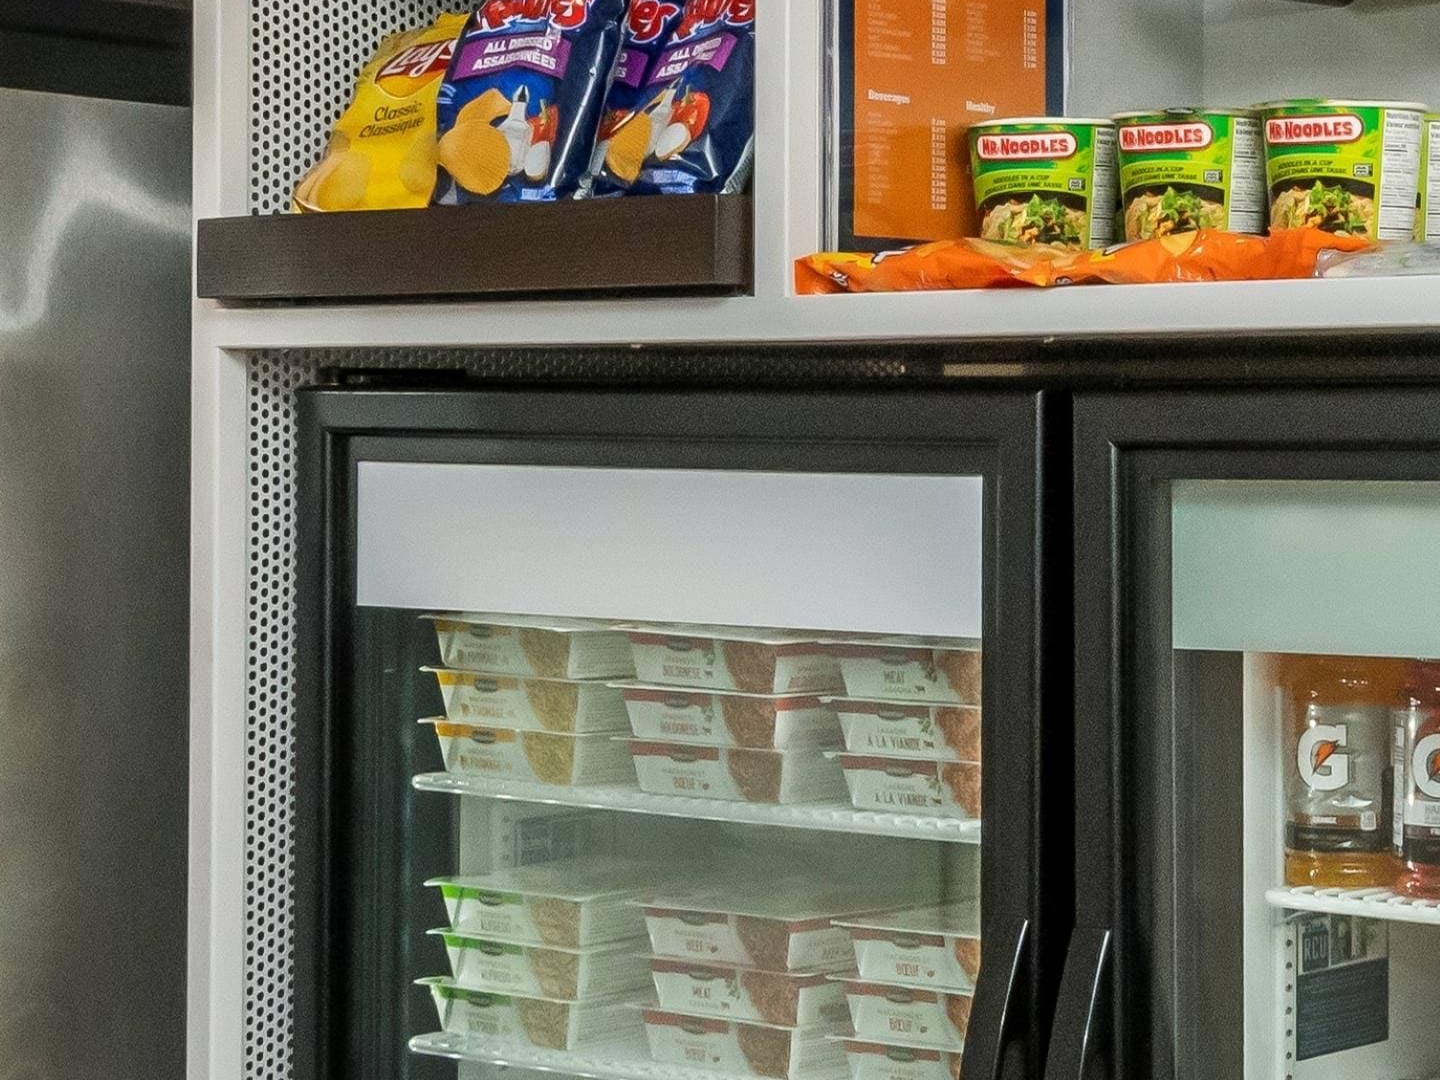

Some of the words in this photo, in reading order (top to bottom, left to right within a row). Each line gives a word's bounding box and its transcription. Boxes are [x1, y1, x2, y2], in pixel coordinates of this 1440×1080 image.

[483, 39, 507, 55] ALL
[668, 46, 691, 62] ALL
[867, 89, 911, 105] Beverages
[373, 100, 423, 123] Classic
[358, 117, 425, 139] Classique
[1284, 121, 1353, 140] NOODLES
[1137, 128, 1204, 146] NOODLES
[1000, 138, 1069, 155] NOODLES
